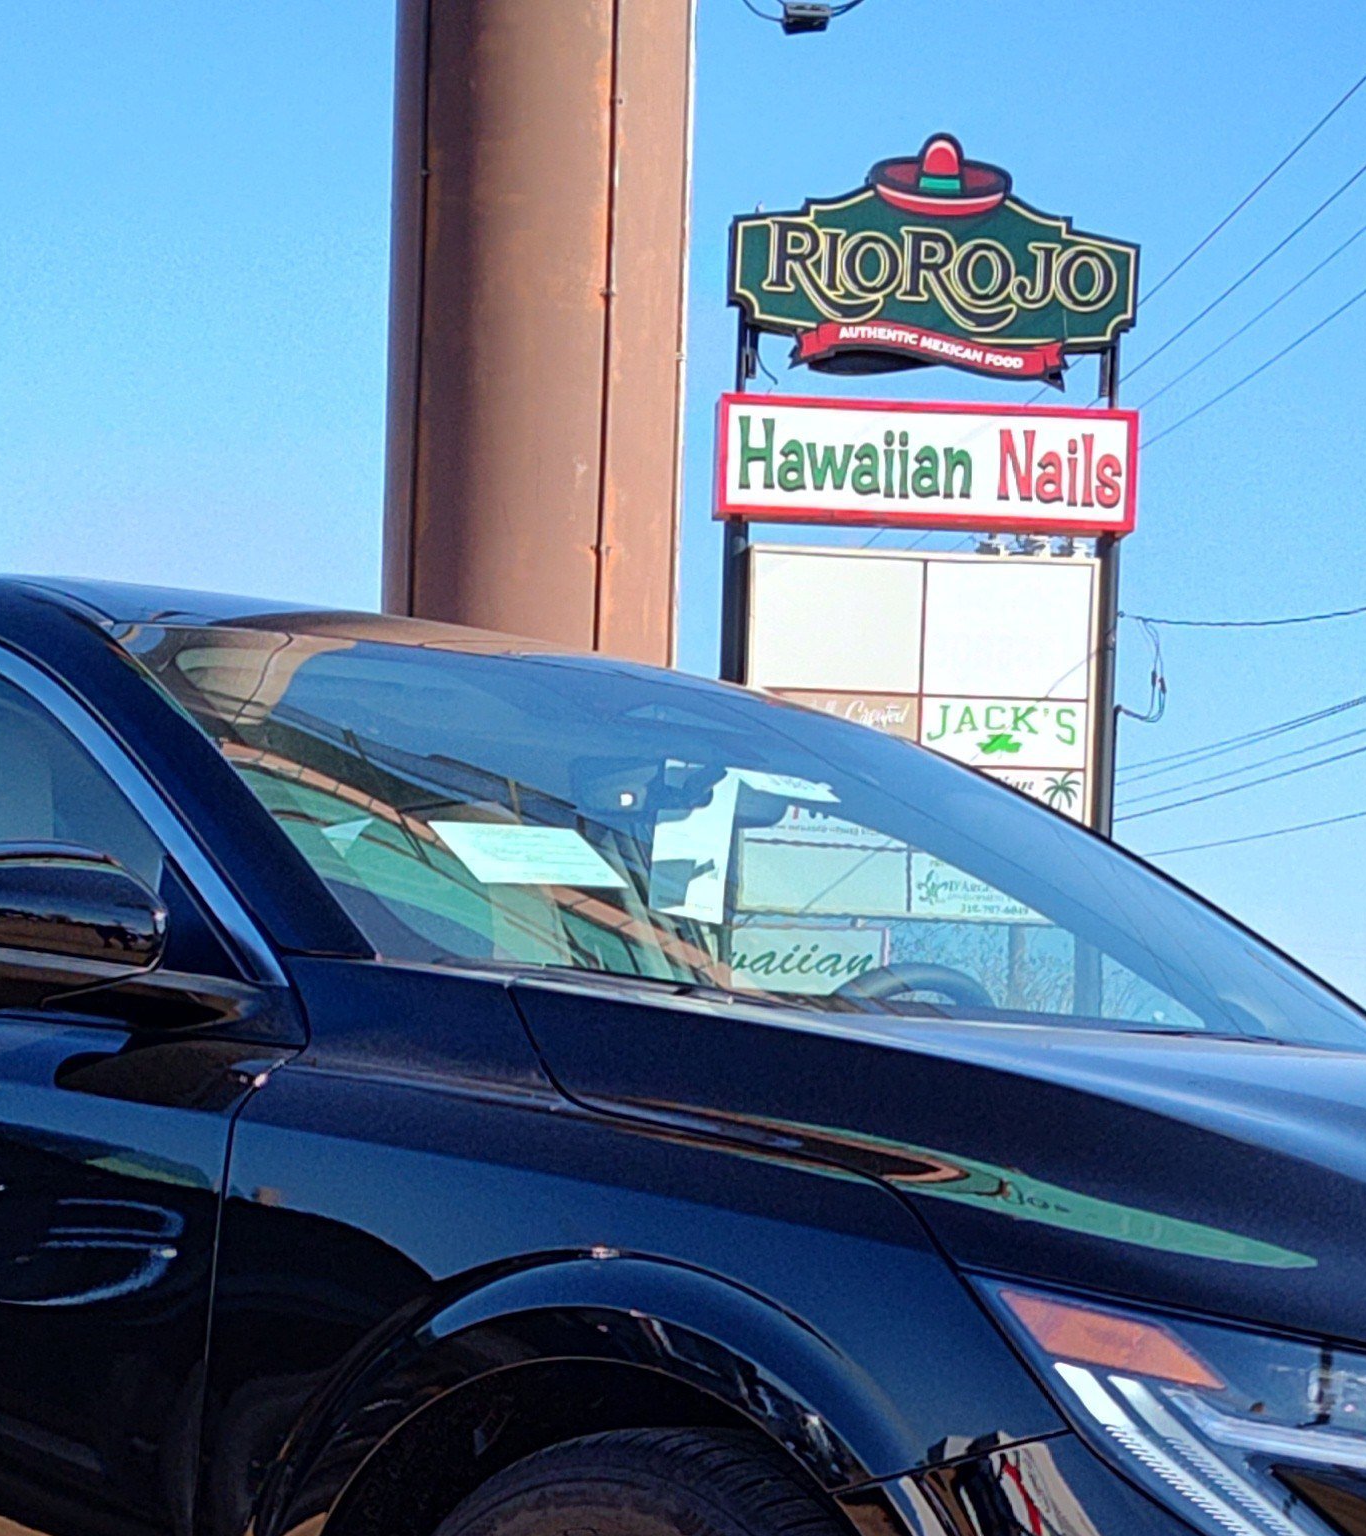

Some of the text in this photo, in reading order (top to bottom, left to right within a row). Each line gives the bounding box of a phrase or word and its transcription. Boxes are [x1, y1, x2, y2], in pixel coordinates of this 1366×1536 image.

[839, 325, 1024, 370] AUTHENTIC MEXICAN FOOD
[737, 414, 1123, 509] Hawaiian Nails
[926, 703, 1077, 746] JACK'S
